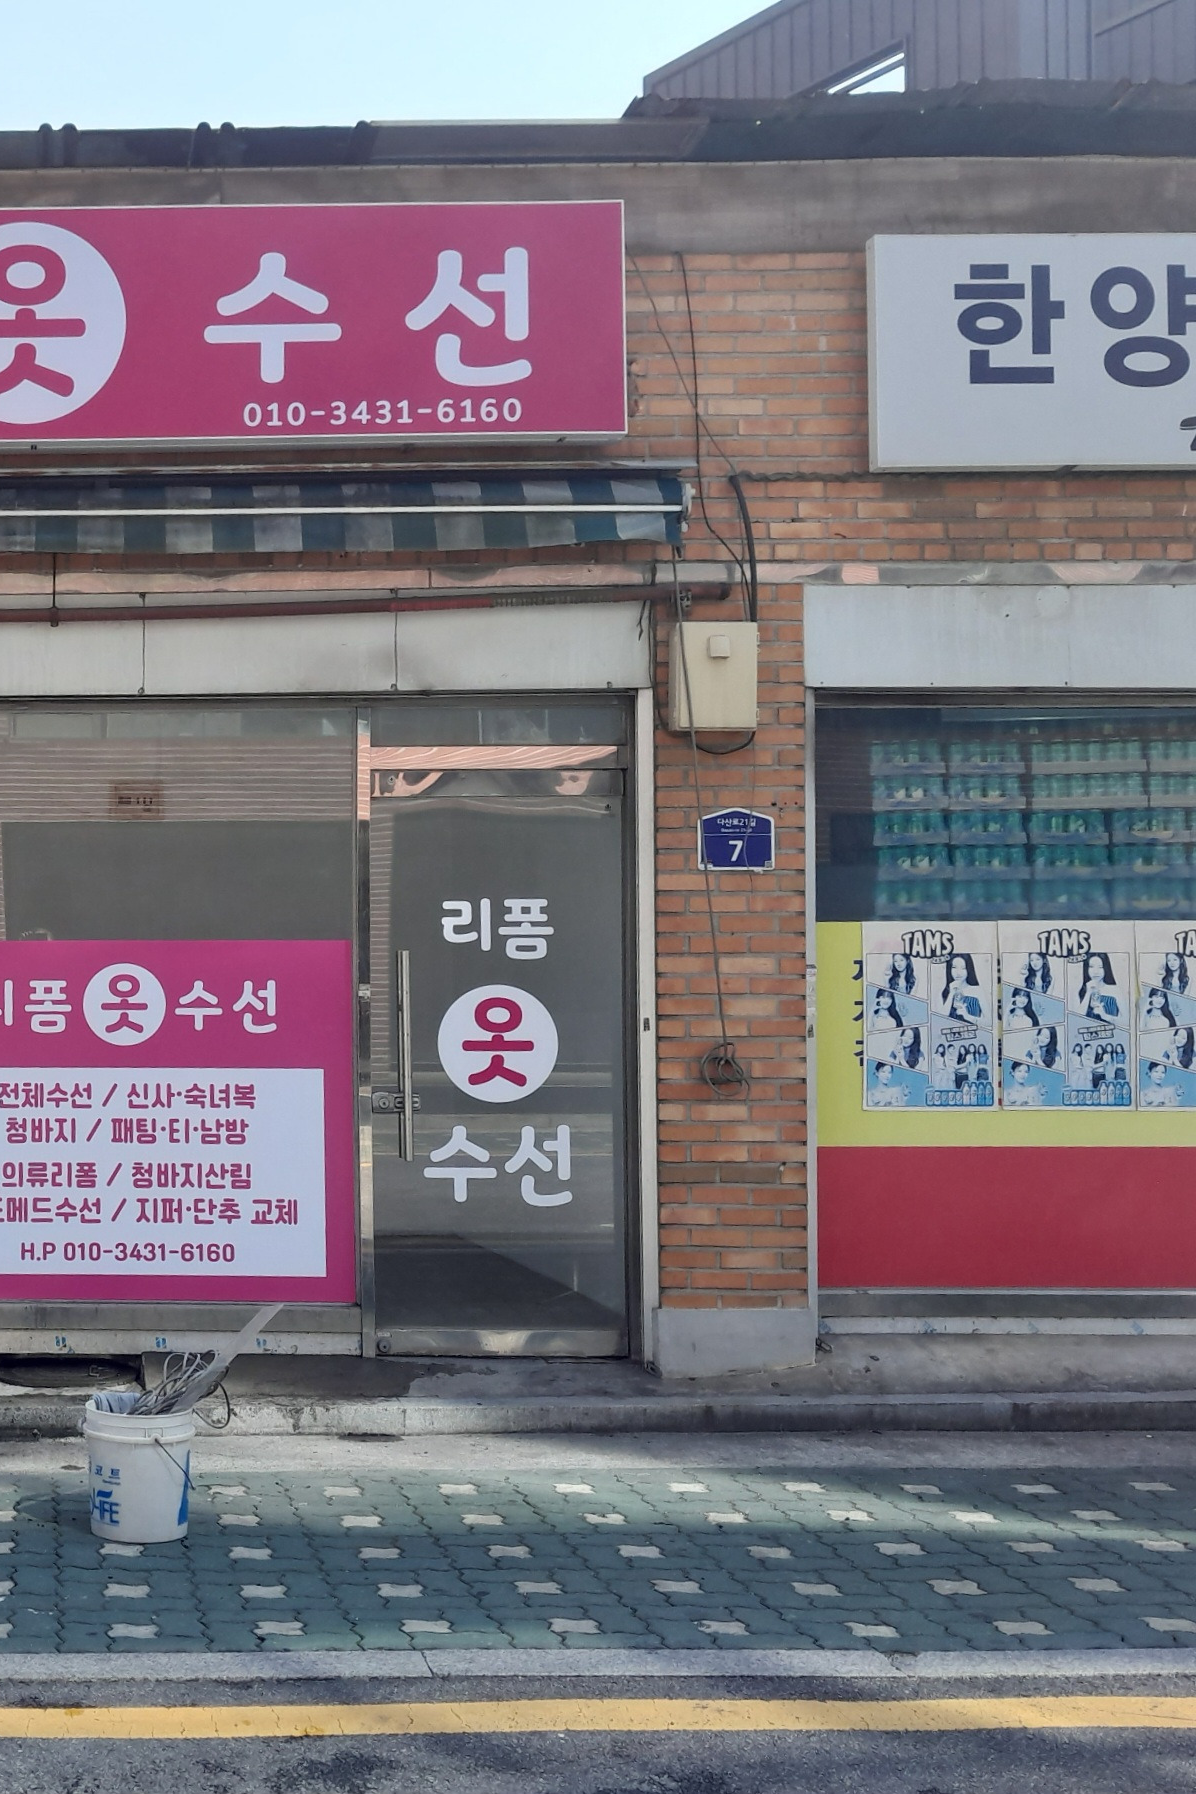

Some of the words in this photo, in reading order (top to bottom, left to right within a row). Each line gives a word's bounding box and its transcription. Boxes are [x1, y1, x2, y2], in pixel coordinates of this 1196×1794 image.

[204, 246, 532, 387] 수선
[243, 398, 522, 427] 010-3431-6160
[728, 840, 743, 862] 7
[441, 897, 555, 960] 리폼
[1037, 928, 1091, 958] TAMS
[901, 929, 954, 959] TAMS
[101, 974, 148, 1034] 옷
[175, 979, 278, 1034] 수선
[462, 997, 535, 1087] 옷
[102, 1083, 118, 1107] /
[6, 1117, 76, 1144] 청바지
[86, 1118, 102, 1142] /
[2, 1162, 98, 1188] 의류리폼
[106, 1163, 122, 1187] /
[132, 1162, 252, 1189] 청바지산림
[423, 1124, 573, 1207] 수선
[111, 1198, 127, 1222] /
[251, 1199, 298, 1225] 교체
[21, 1242, 56, 1261] H.P
[63, 1242, 236, 1262] 010-3431-6160
